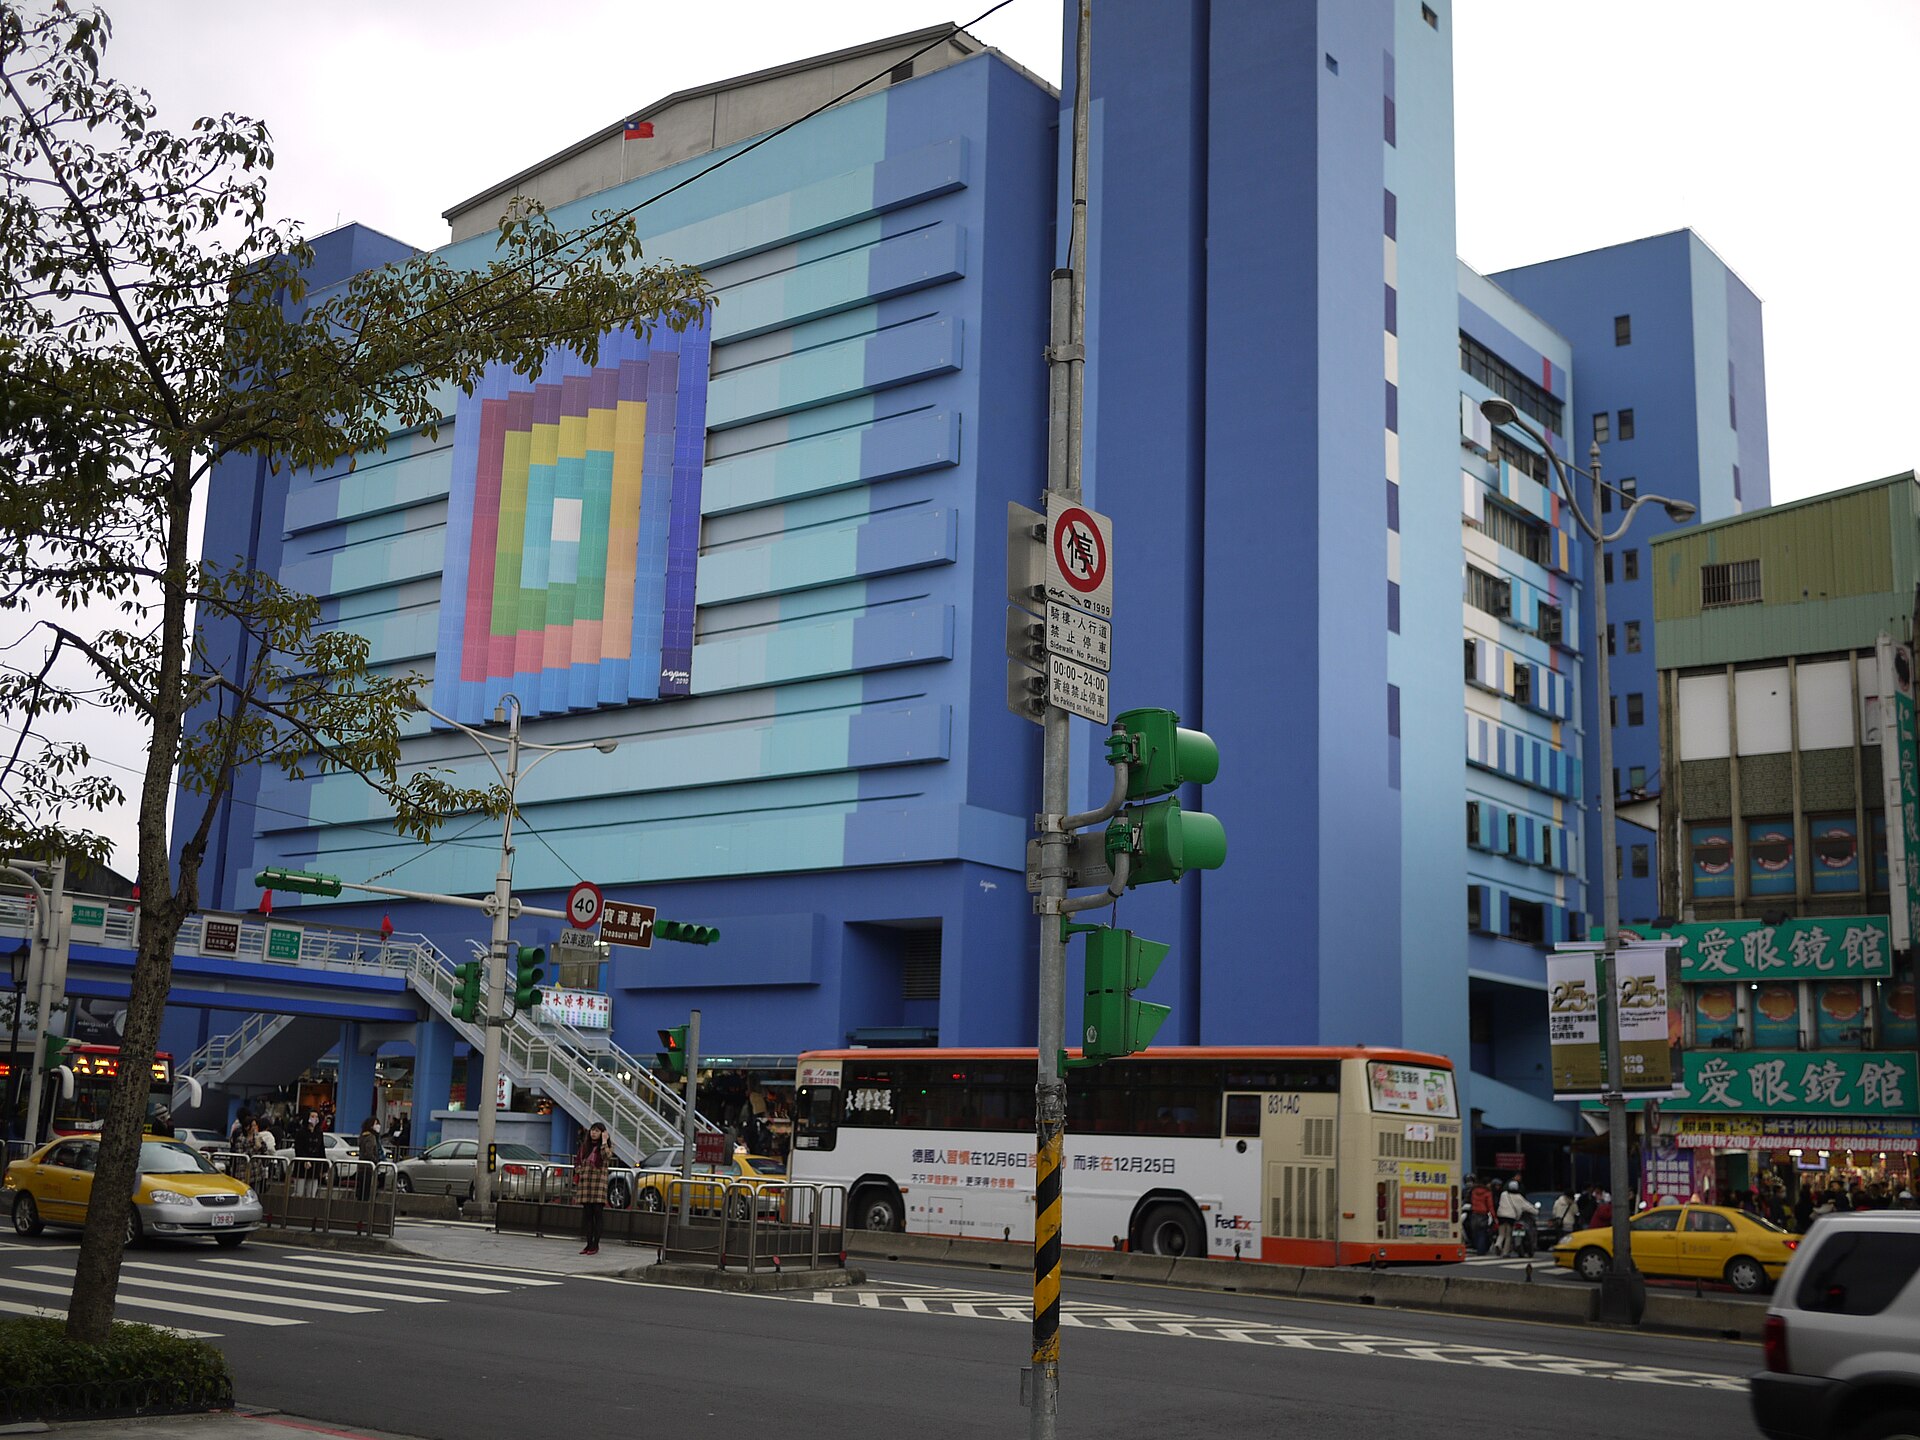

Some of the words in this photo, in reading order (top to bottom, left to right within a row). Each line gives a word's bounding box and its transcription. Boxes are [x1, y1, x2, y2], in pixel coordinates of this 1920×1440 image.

[1067, 529, 1094, 574] 停
[1092, 602, 1110, 616] 1999
[1050, 624, 1107, 654] 禁止停車
[1050, 640, 1074, 656] Sidewalk
[1076, 649, 1084, 658] No
[1087, 652, 1106, 668] Parking
[1054, 694, 1059, 704] No
[1061, 697, 1075, 711] Parking
[1084, 705, 1095, 716] Yellow
[1096, 709, 1104, 720] Line
[574, 898, 594, 914] 40
[562, 932, 594, 948] 公車速限
[602, 928, 628, 939] Treasure
[628, 930, 638, 940] Hill
[553, 993, 596, 1010] 水源市場
[78, 1020, 109, 1028] elegant
[1657, 1058, 1906, 1108] 愛眼鏡館
[1268, 1094, 1300, 1114] 831-AC
[1215, 1214, 1251, 1229] FedEx
